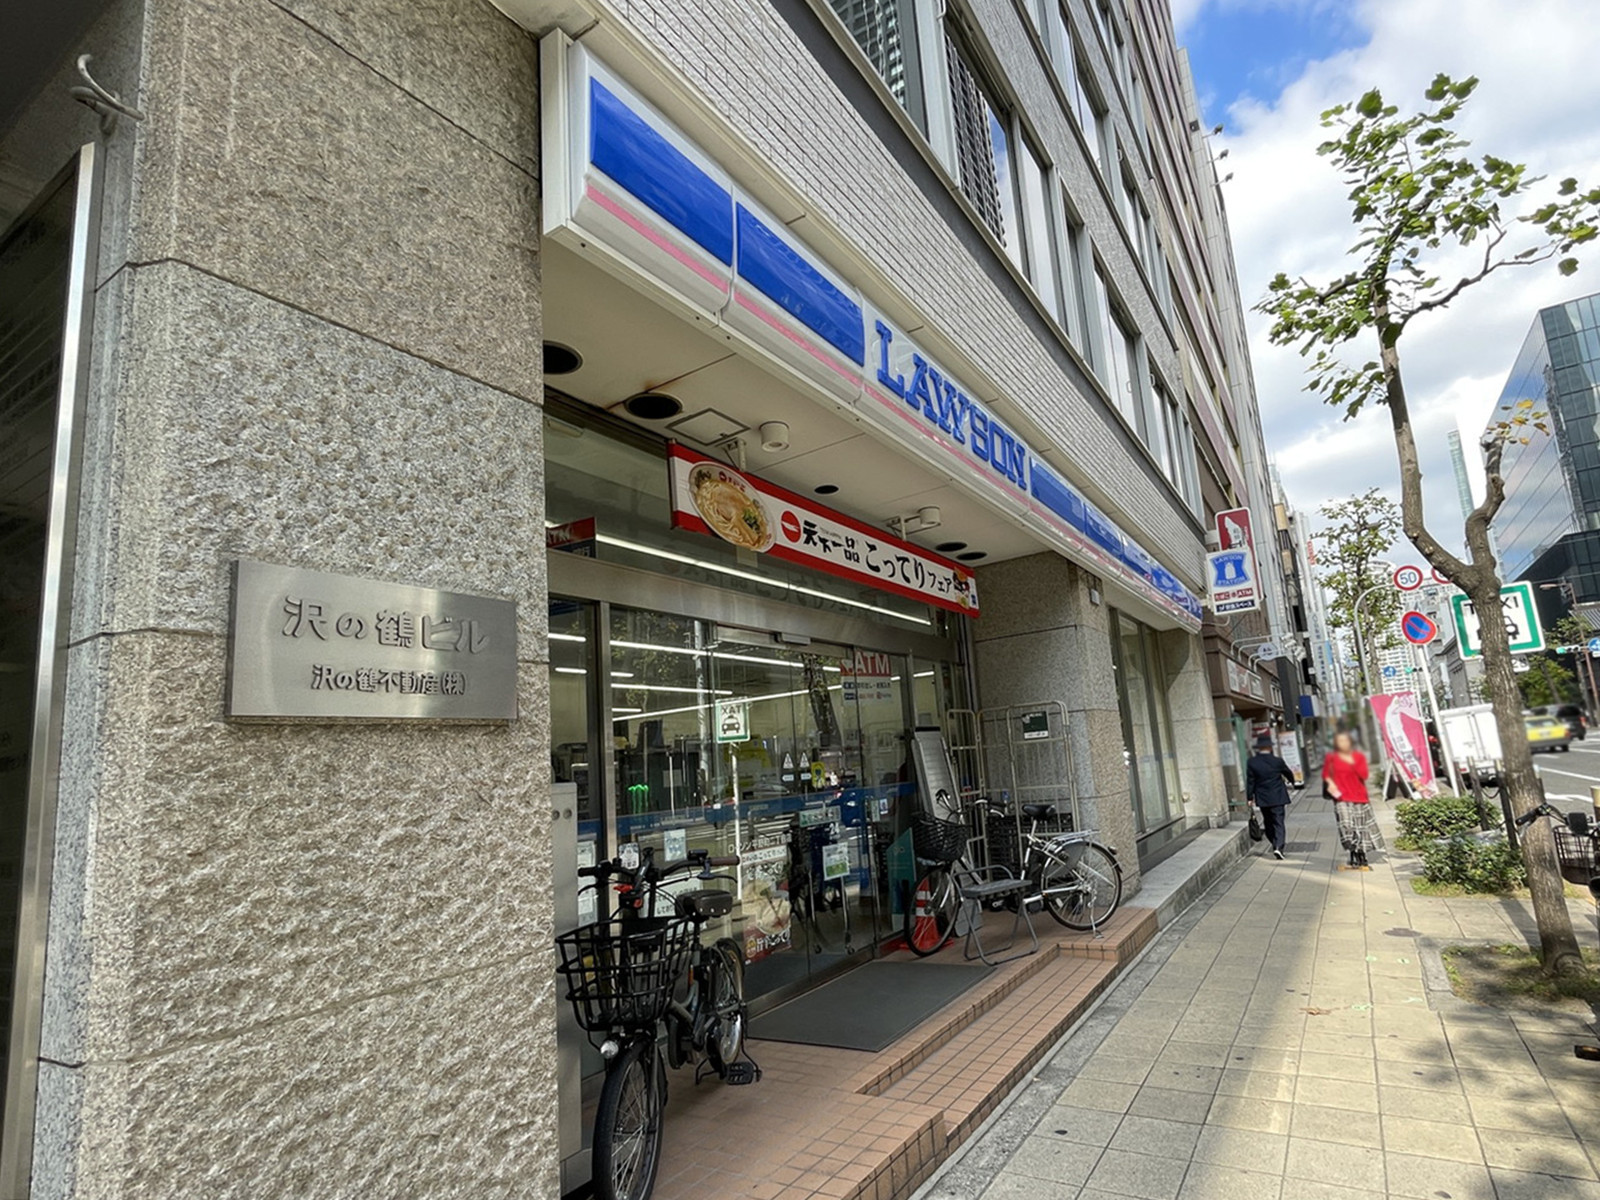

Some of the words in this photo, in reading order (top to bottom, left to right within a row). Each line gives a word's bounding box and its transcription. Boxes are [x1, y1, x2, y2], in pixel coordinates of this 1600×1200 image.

[875, 319, 1027, 491] LAWSON
[803, 519, 860, 564] 天下一品
[1400, 571, 1417, 585] 50
[1464, 596, 1519, 614] TXI
[282, 595, 490, 653] 沢の鶴ビル
[855, 651, 890, 674] ATM
